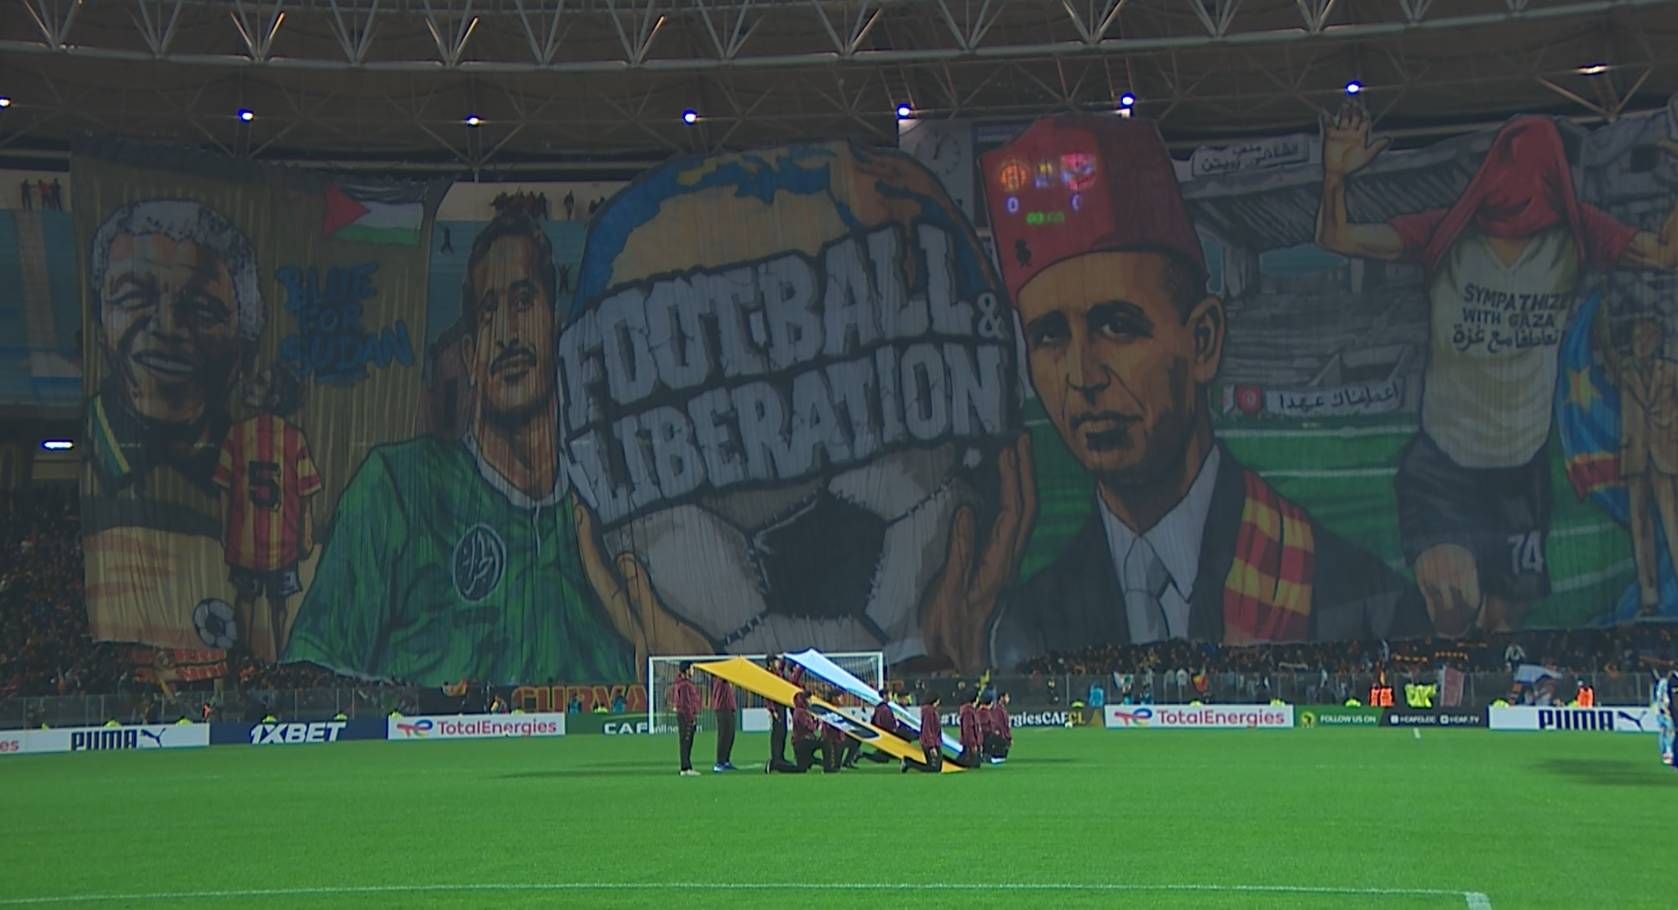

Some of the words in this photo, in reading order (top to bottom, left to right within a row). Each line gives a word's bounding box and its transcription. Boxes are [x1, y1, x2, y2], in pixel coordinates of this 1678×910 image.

[1463, 283, 1568, 311] SYMPATHIZE
[558, 222, 973, 430] FOOTBALL
[977, 291, 1007, 338] &
[1462, 307, 1500, 324] WITH
[1508, 312, 1554, 328] GAZA
[279, 320, 415, 374] SUDAN
[568, 340, 1003, 525] LIBERATION
[248, 460, 280, 507] 5
[1507, 530, 1544, 576] 74
[437, 719, 557, 737] TotalEnergies
[1157, 709, 1285, 727] TotalEnergies
[1319, 714, 1351, 724] FOLLOW
[1352, 714, 1363, 724] US
[1364, 714, 1377, 724] ON
[1538, 709, 1614, 730] PUMA
[71, 730, 137, 750] PUMA
[250, 722, 347, 744] 1XBET
